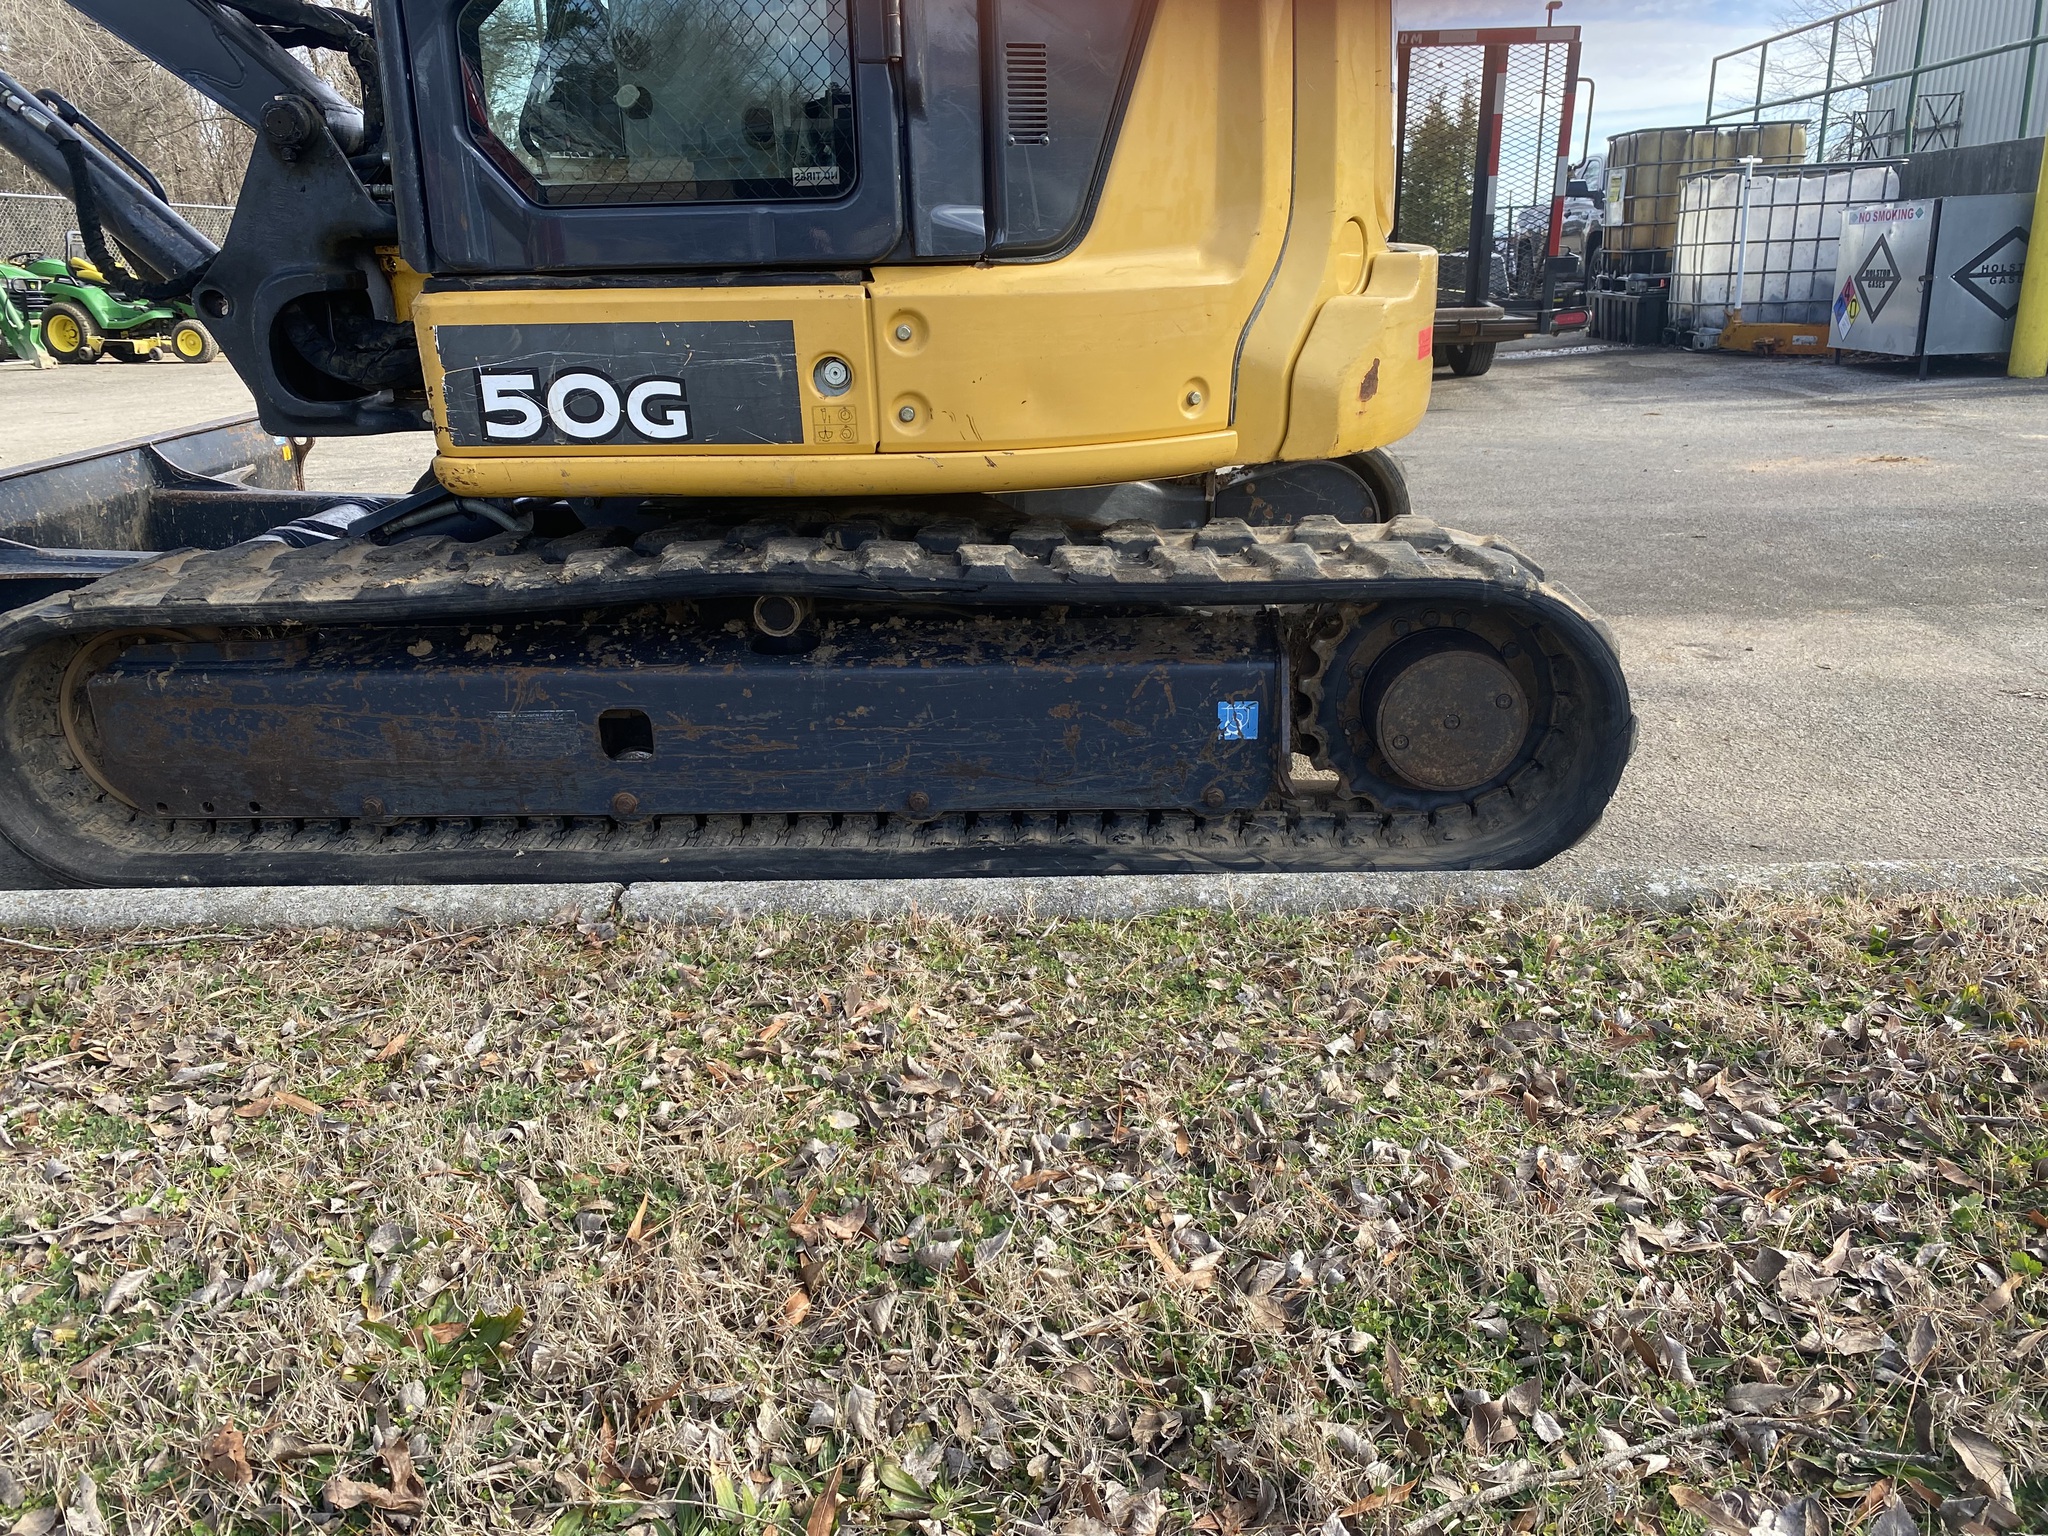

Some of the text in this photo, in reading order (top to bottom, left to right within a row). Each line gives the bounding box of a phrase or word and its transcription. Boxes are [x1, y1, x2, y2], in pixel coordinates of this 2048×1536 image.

[1859, 207, 1914, 223] NO SMOKING
[1844, 281, 1851, 302] 4
[1868, 280, 1886, 289] GASES
[1849, 298, 1857, 319] 0
[480, 373, 688, 438] 50G
